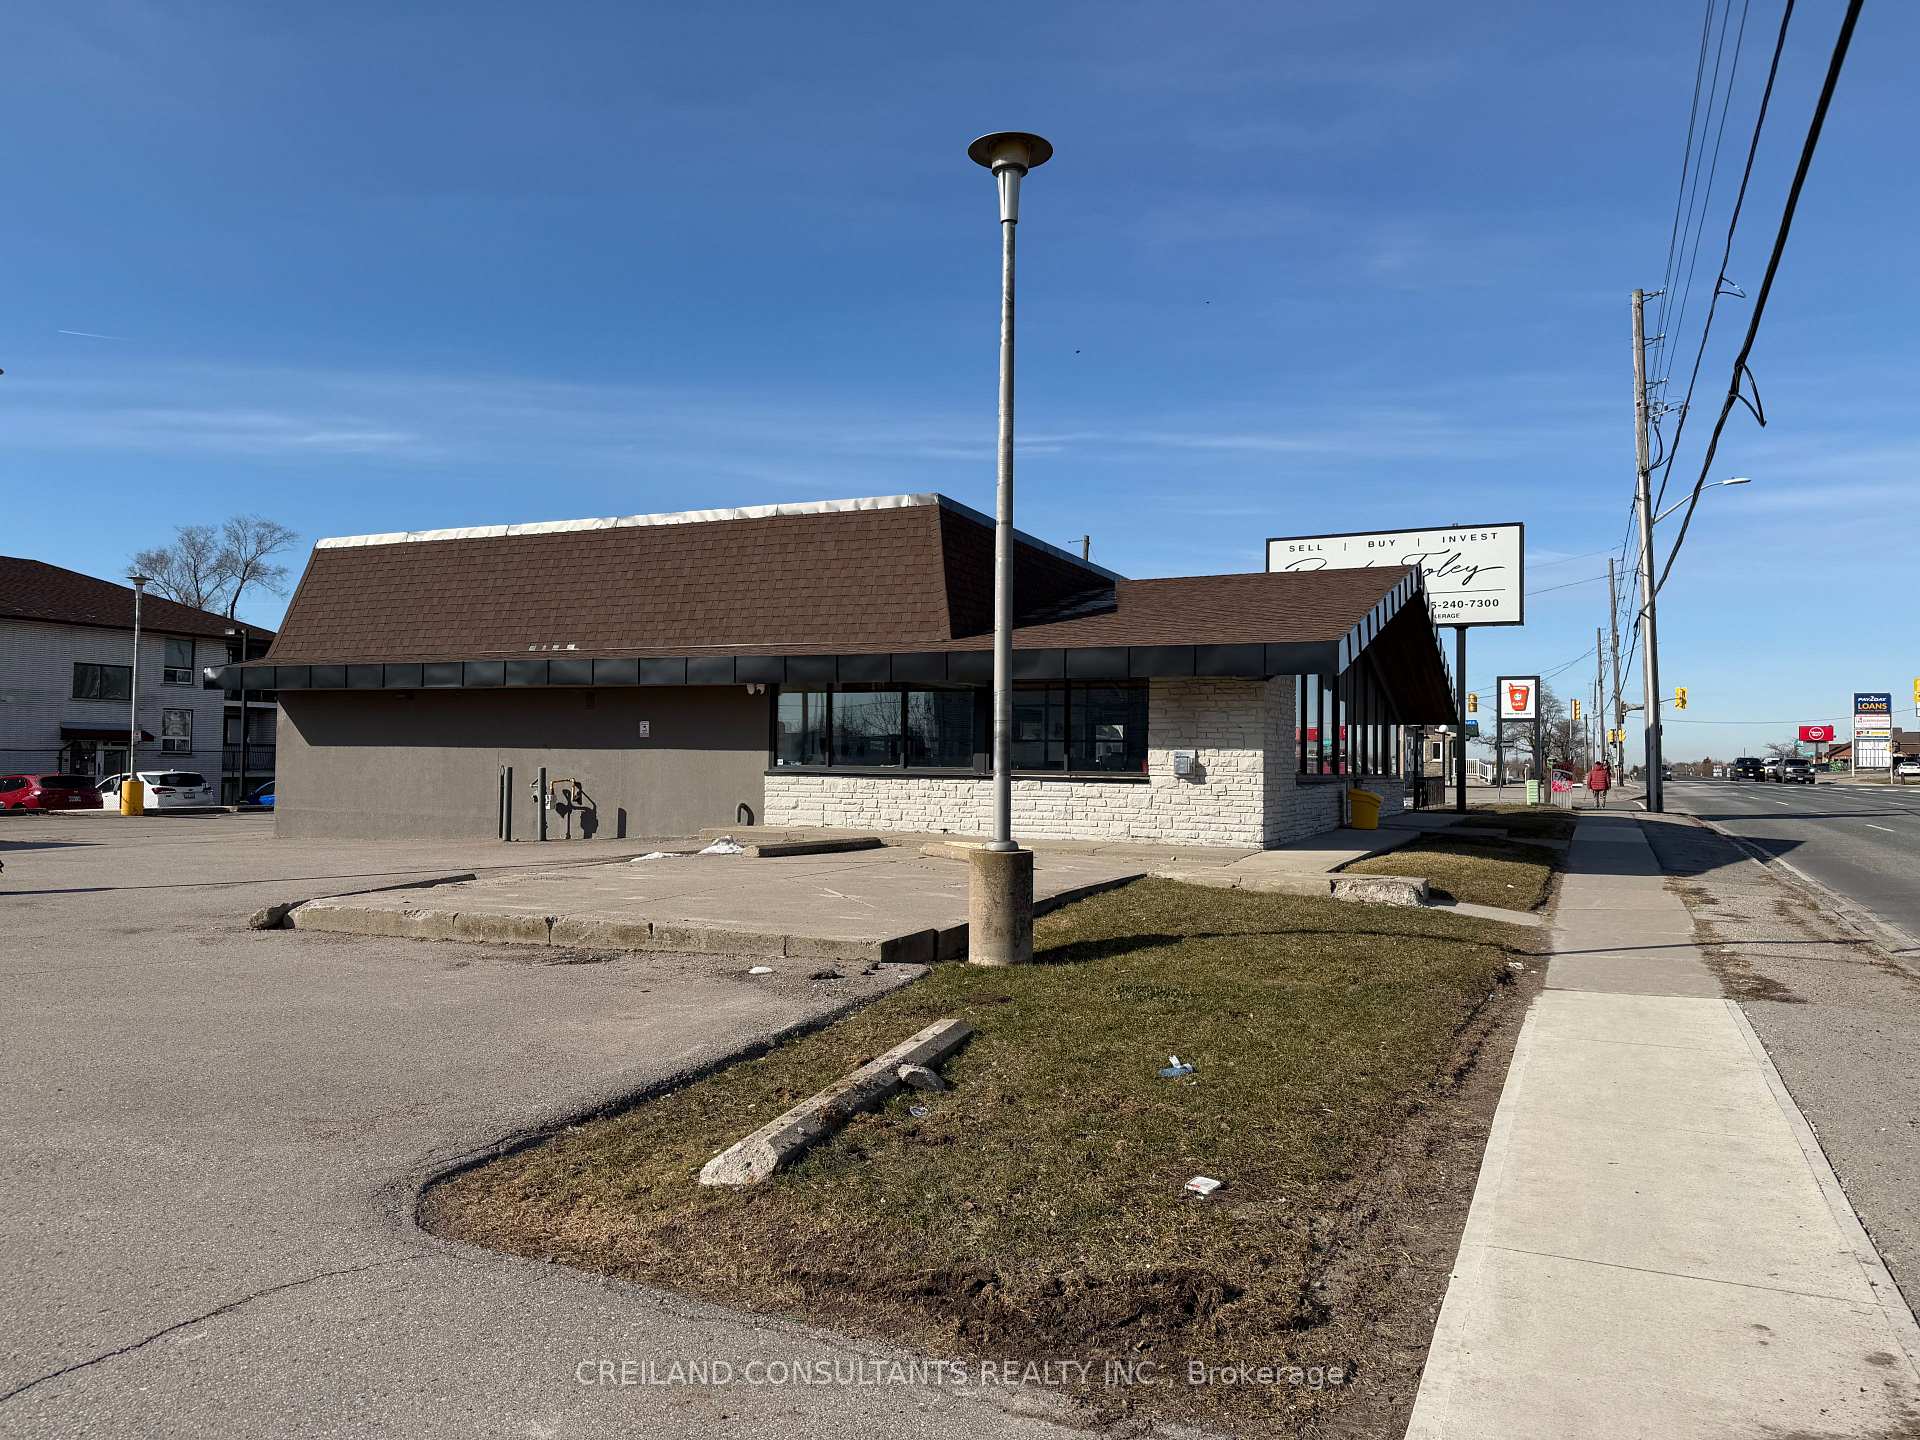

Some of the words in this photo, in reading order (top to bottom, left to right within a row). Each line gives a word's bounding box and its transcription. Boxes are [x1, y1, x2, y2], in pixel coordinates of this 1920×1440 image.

[1289, 544, 1323, 552] SELL
[1368, 540, 1396, 548] BUY
[1442, 532, 1498, 543] INVEST
